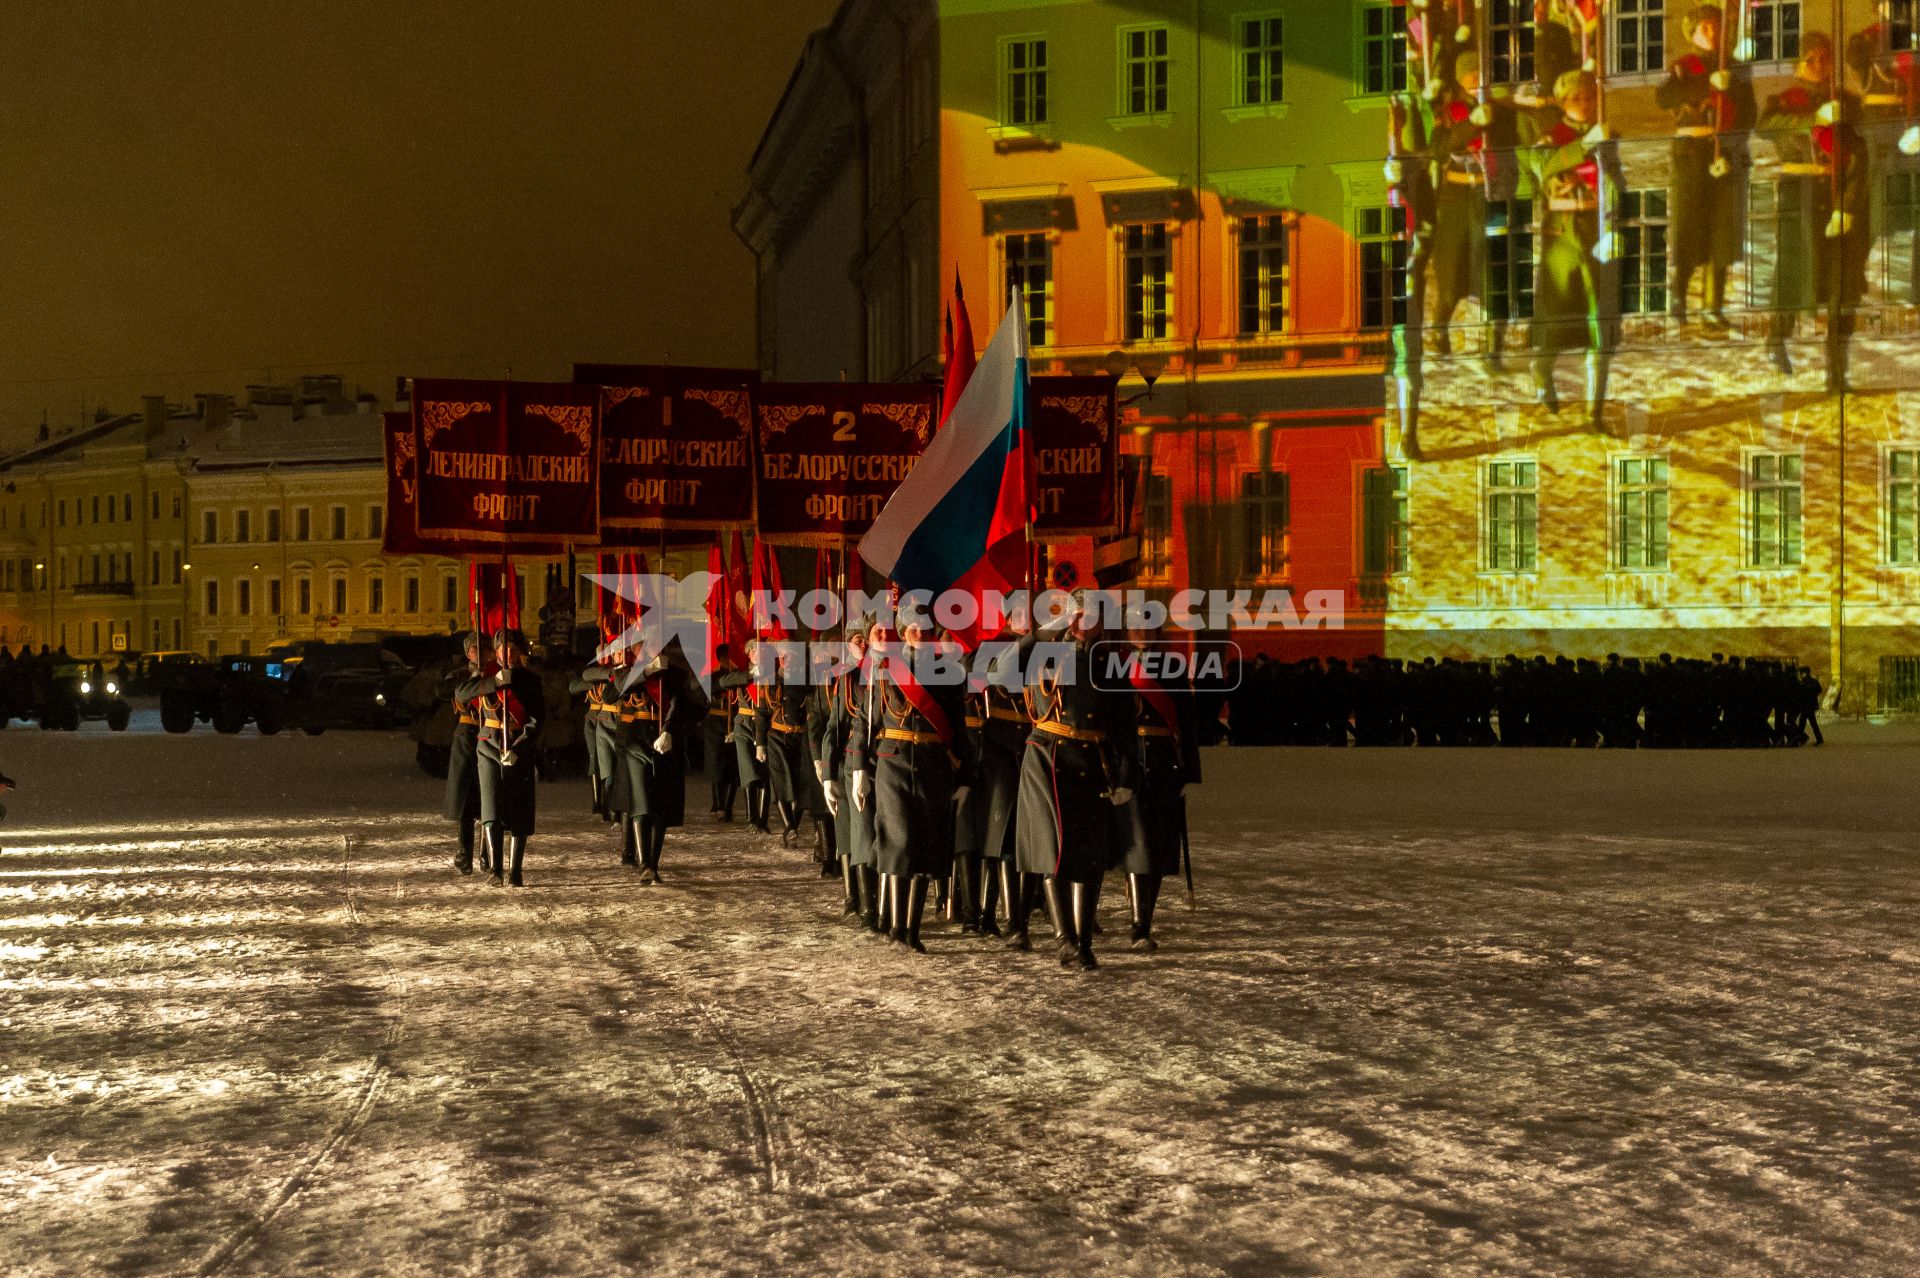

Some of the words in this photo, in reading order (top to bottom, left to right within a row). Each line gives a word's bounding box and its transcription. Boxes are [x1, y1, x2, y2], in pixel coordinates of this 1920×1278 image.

[832, 411, 857, 442] 2
[601, 435, 747, 467] ЕЛОРУССКИЙ
[425, 449, 590, 484] ЛЕНИНГРАДСКИЙ
[473, 492, 542, 521] ФРОНТ
[625, 478, 702, 506] ФРОНТ
[805, 494, 883, 521] ФРОНТ
